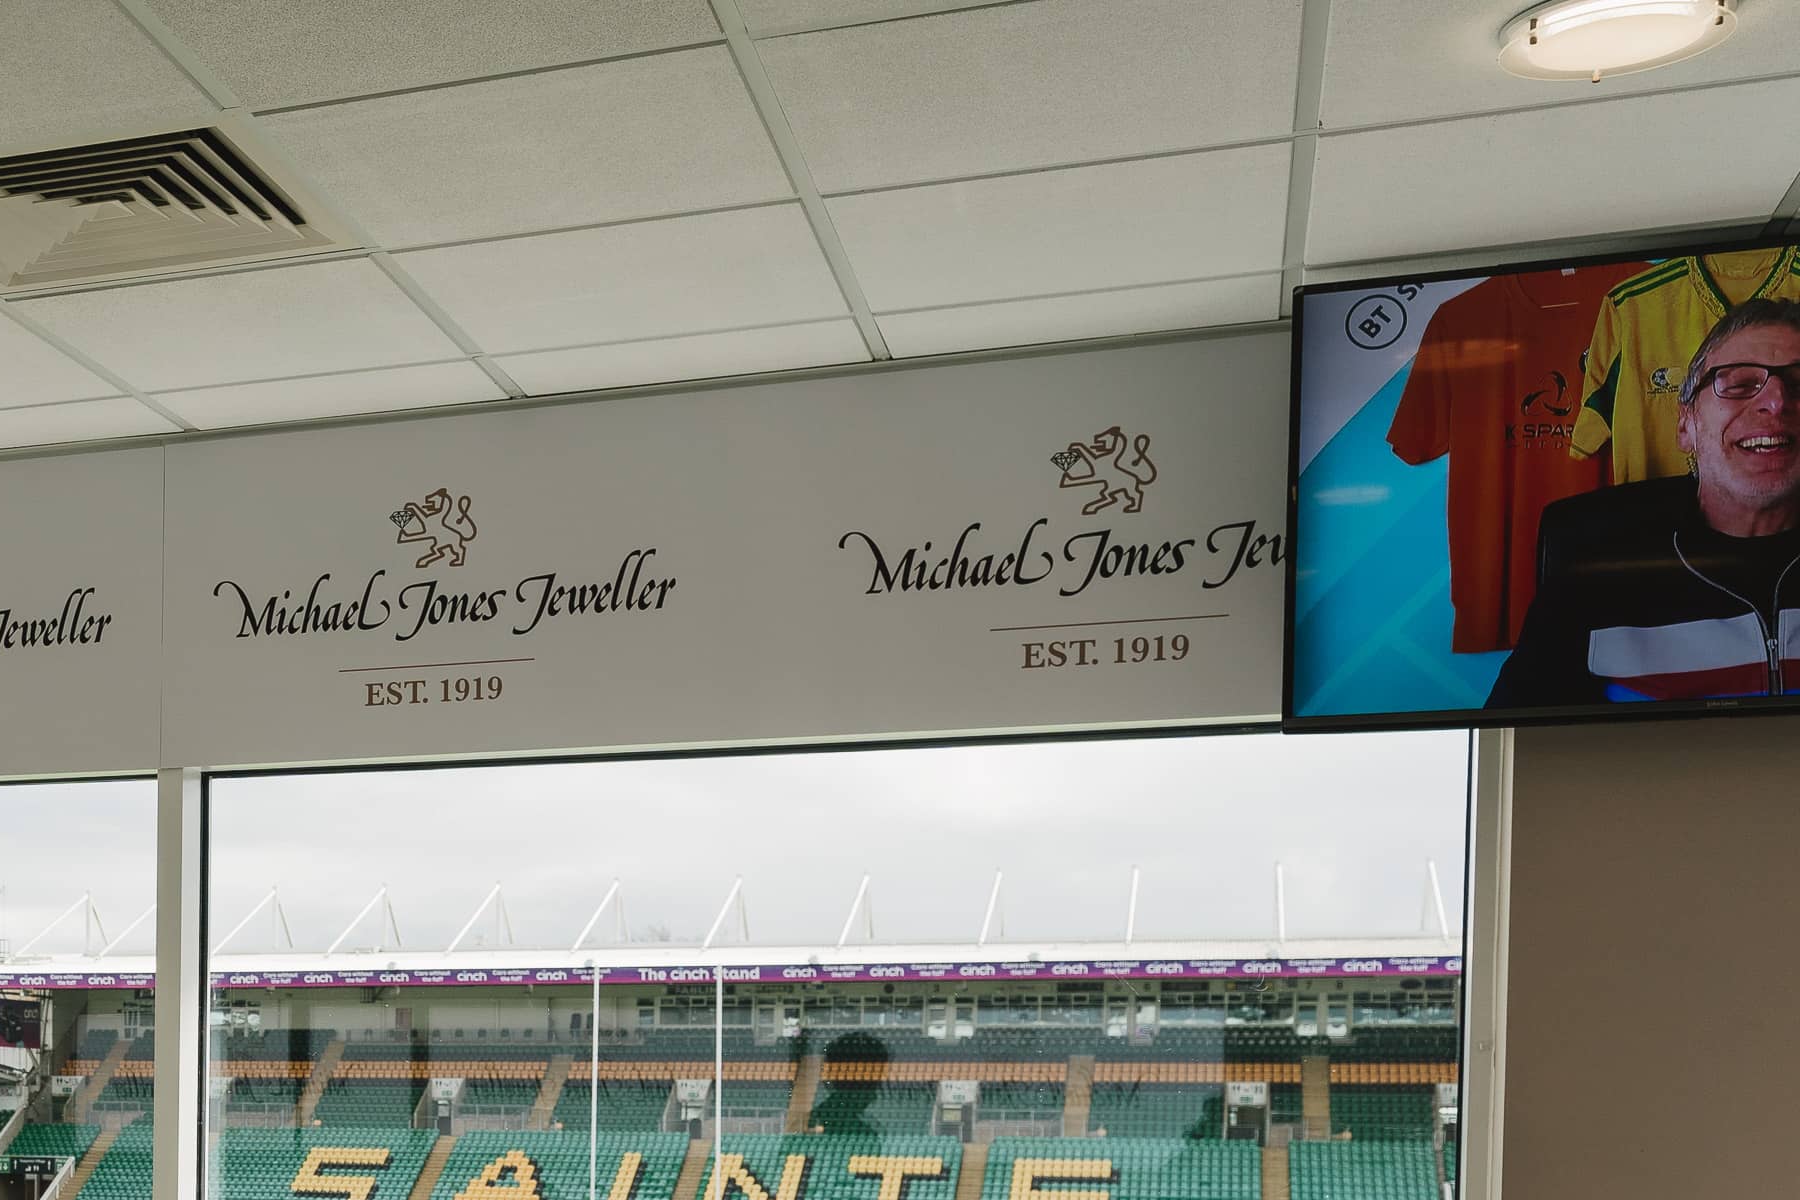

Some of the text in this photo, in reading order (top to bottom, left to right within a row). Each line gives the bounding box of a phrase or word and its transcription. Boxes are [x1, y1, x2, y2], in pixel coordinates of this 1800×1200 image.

[1358, 305, 1392, 339] BT
[838, 518, 1054, 597] Michael
[1058, 530, 1195, 597] Jones
[213, 549, 677, 643] Michael Jones Jeweller
[1021, 633, 1191, 670] EST. 1919
[364, 675, 502, 708] EST. 1919
[380, 972, 409, 982] cinch
[457, 971, 487, 982] cinch
[536, 970, 567, 980] cinch
[638, 968, 666, 981] The
[670, 968, 709, 980] cinch
[783, 967, 816, 978] cinch
[869, 966, 904, 977] cinch
[20, 975, 46, 986] cinch
[88, 975, 115, 985] cinch
[230, 974, 258, 984] cinch
[304, 973, 333, 984] cinch
